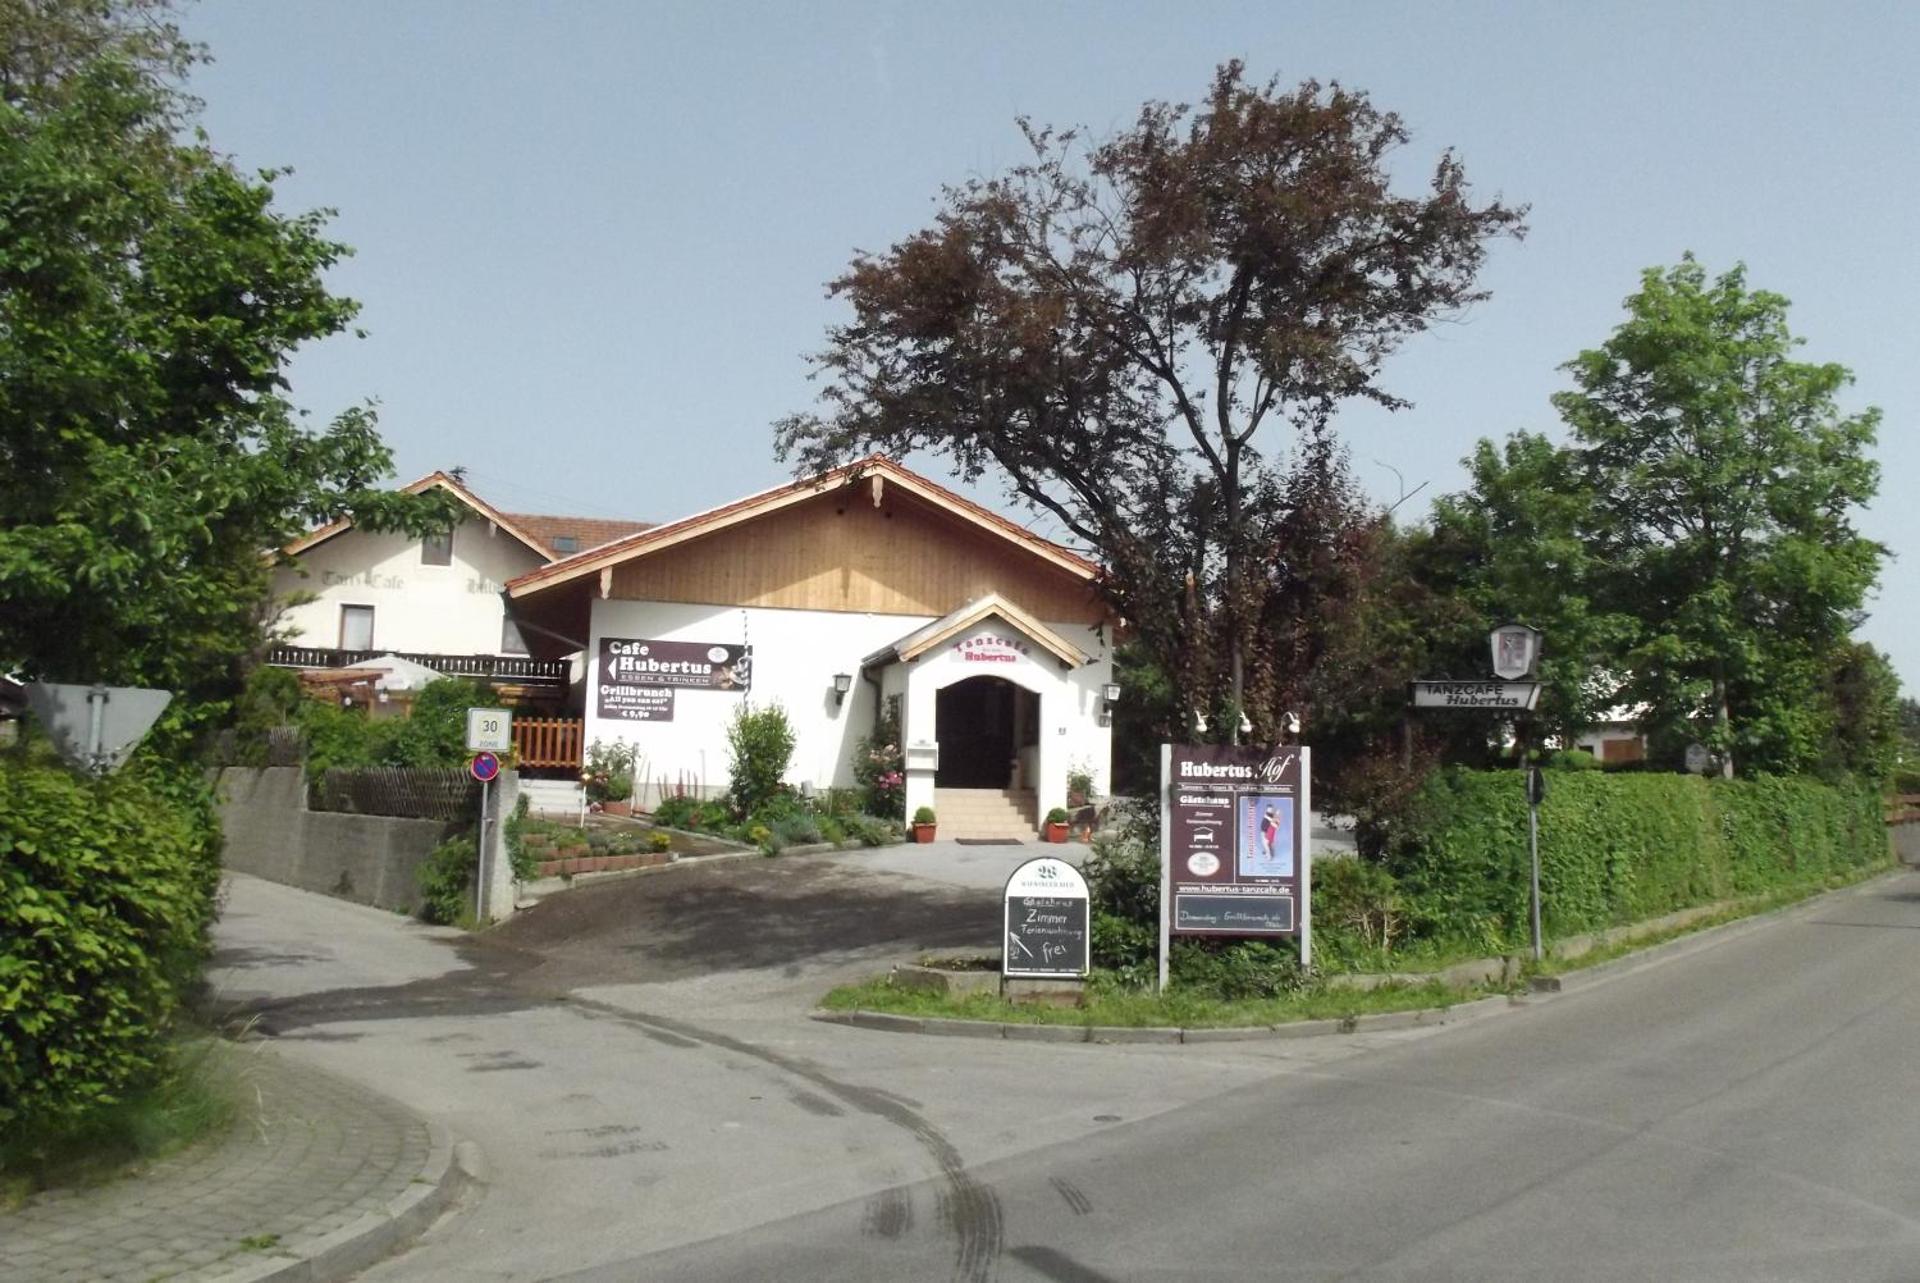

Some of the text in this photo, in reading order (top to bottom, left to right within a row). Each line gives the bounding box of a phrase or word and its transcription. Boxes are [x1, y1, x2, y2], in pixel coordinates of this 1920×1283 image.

[609, 641, 650, 656] Cafe
[965, 652, 1016, 662] Hubertus
[619, 656, 712, 675] Hubertus
[621, 674, 654, 682] ESSEN
[667, 676, 709, 685] TRINKEN
[600, 685, 672, 698] Grillbrunch
[1426, 685, 1503, 695] TANZCAFE
[1446, 695, 1519, 706] Hubertus
[483, 720, 498, 733] 30
[1181, 753, 1294, 783] Hubertus Hof
[1180, 795, 1230, 805] Gästehaus
[1026, 908, 1068, 924] Zimmer
[1042, 941, 1067, 963] frei
